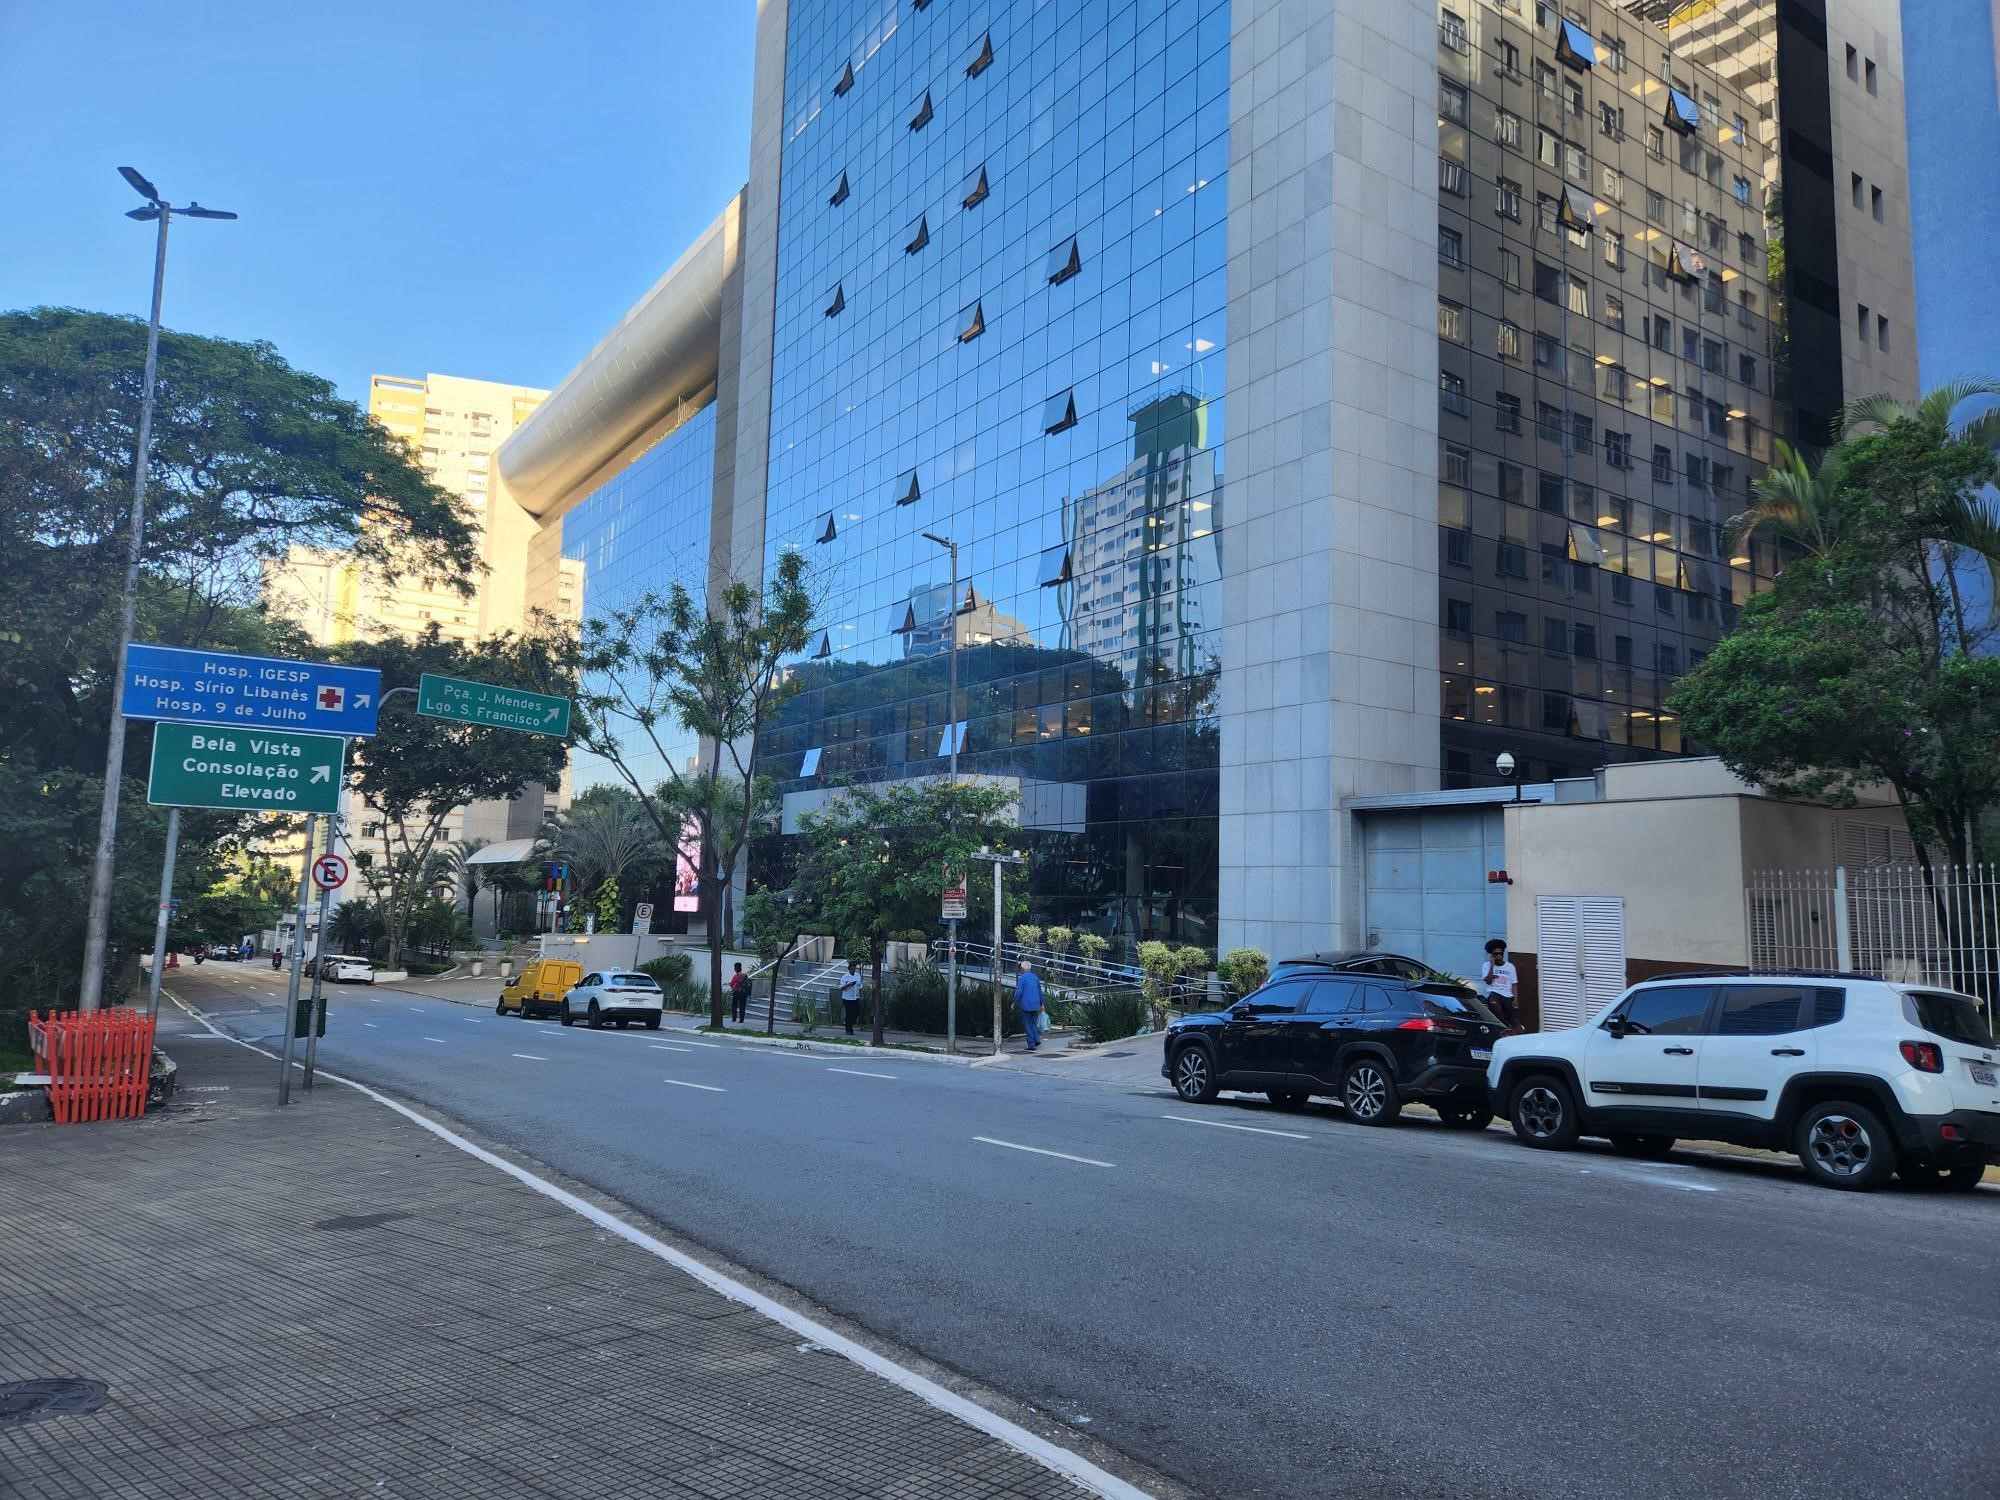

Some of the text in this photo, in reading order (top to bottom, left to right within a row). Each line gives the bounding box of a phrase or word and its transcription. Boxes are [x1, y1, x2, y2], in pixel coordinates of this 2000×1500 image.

[204, 662, 311, 683] Hosp. IGESP
[134, 674, 309, 702] Hosp. Sírio Libanês
[443, 685, 542, 711] Pça. J. Mendes
[156, 696, 307, 721] Hosp. 9 de Julho
[425, 698, 541, 727] Lgo. S. Francisco
[191, 735, 302, 757] Bela Vista
[182, 757, 299, 781] Consolação
[220, 783, 297, 801] Elevado
[640, 907, 648, 916] E
